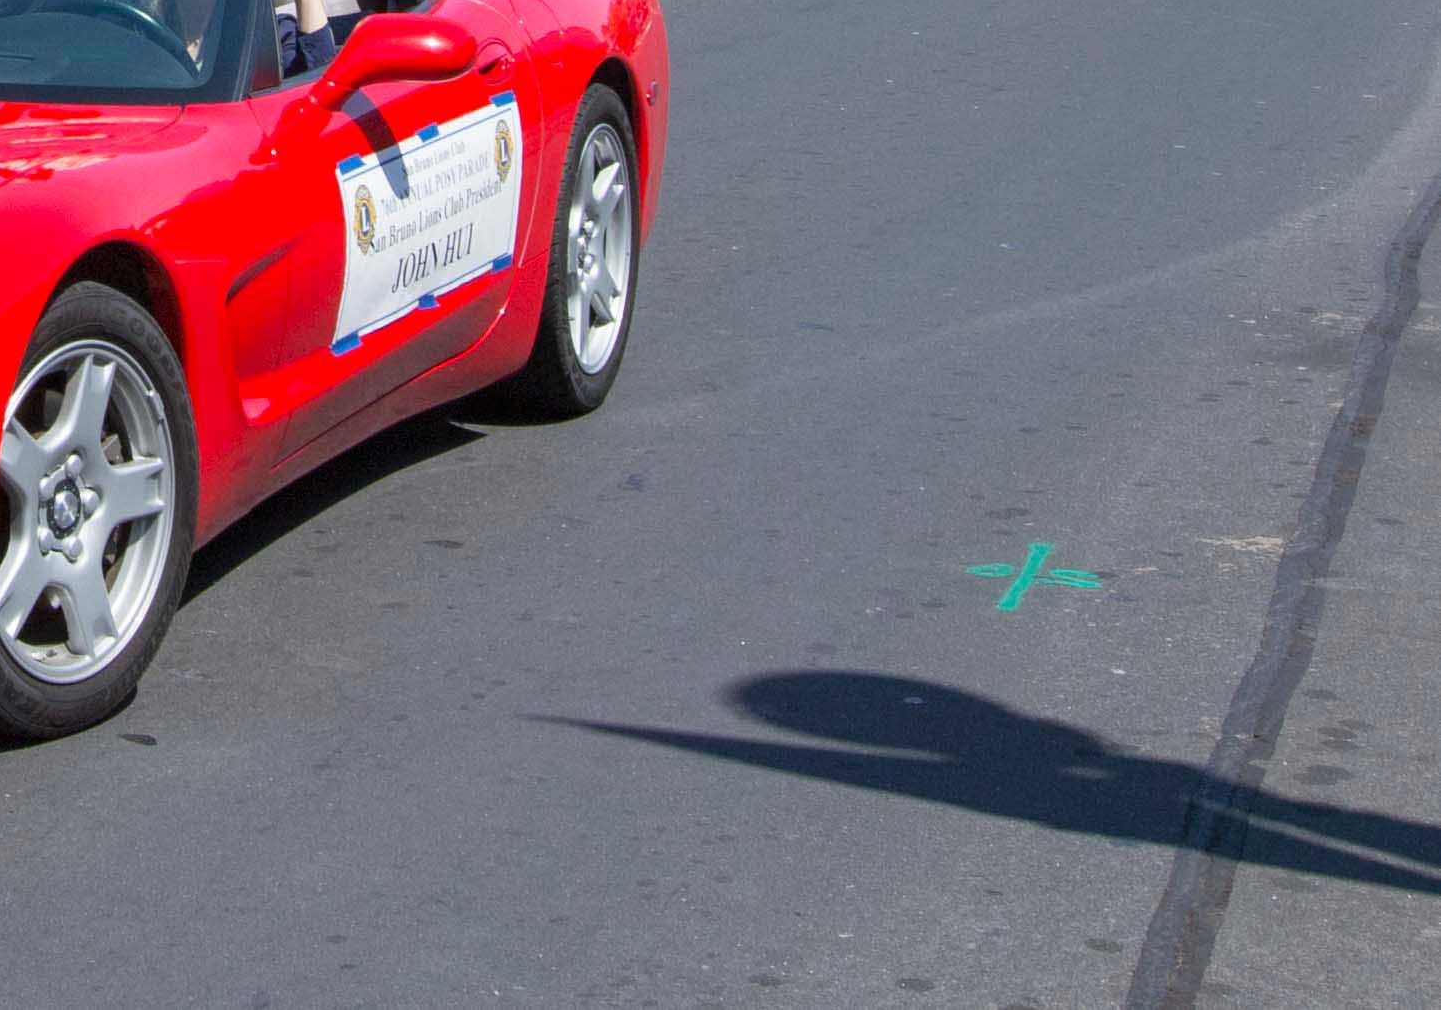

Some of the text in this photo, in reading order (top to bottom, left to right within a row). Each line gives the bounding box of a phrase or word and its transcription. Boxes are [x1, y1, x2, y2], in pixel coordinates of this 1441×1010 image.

[435, 168, 457, 193] POSY
[458, 150, 491, 184] PARADE
[368, 178, 503, 254] San Bruno Lions Club President
[391, 222, 474, 294] JOHN HUI
